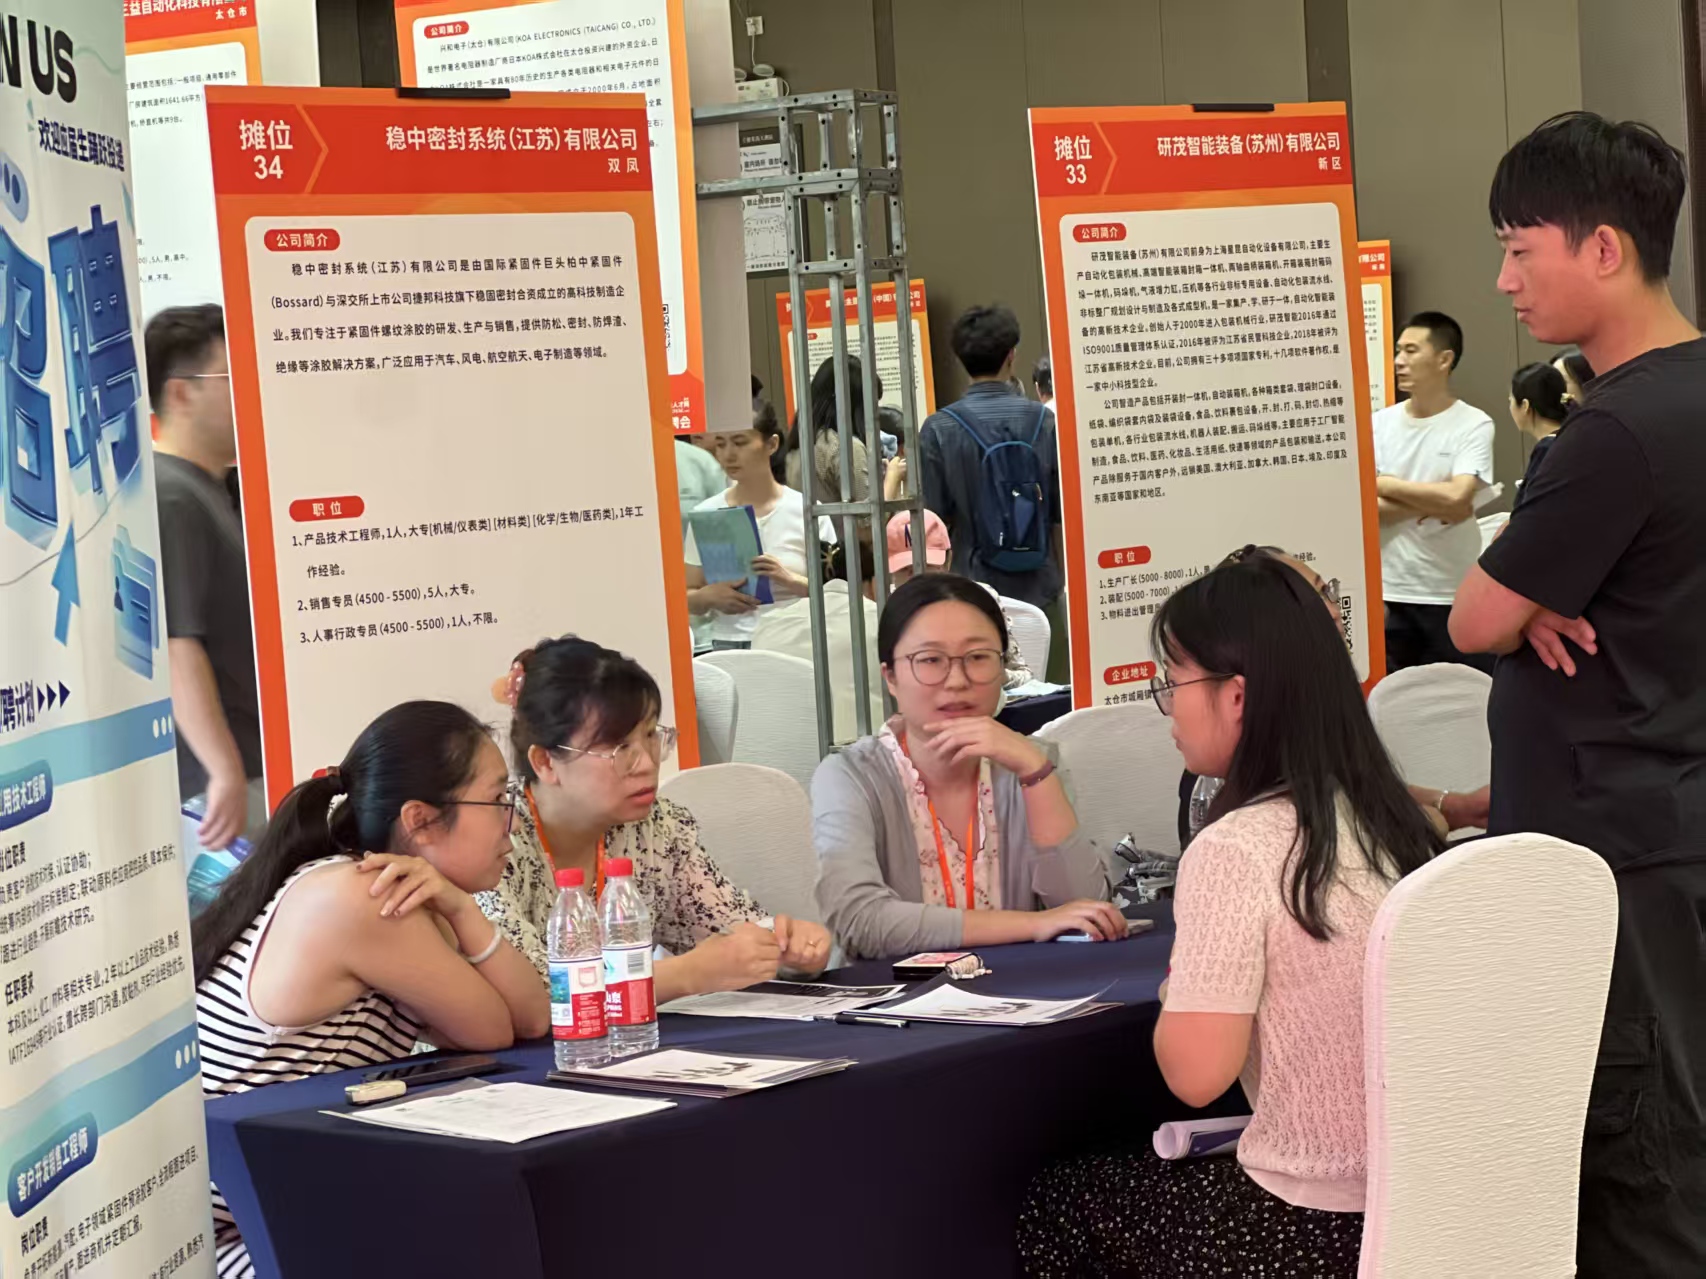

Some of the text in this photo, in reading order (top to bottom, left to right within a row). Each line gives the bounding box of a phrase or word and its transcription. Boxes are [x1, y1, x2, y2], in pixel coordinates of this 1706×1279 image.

[534, 28, 581, 41] ELECTRONICS
[584, 22, 618, 34] (TAICANG)
[27, 19, 77, 103] US
[38, 118, 125, 172] 欢迎应届生踊跃投递
[239, 120, 293, 151] 摊位
[385, 126, 639, 151] 稳中密封系统(江苏)有限公司
[1157, 132, 1341, 157] 研茂智能装备(苏州)有限公司
[1054, 135, 1092, 161] 摊位
[254, 154, 283, 179] 34
[1066, 164, 1087, 184] 33
[275, 233, 329, 248] 公司简介
[1081, 226, 1118, 239] 公司简介
[291, 255, 624, 276] 稳中密封系统(江苏)有限公司是由国际紧固件巨头柏中紧固件
[1086, 380, 1158, 393] 一家中小科技型企业。
[1094, 486, 1166, 504] 东南亚等国家和地区。
[312, 501, 342, 517] 职位
[1114, 551, 1135, 563] 职位
[307, 563, 346, 578] 作经验。
[1112, 667, 1149, 682] 企业地址
[5, 971, 34, 1006] 任职要求
[16, 1126, 89, 1203] 客户开发销售工程师
[21, 1215, 49, 1257] 岗位职责
